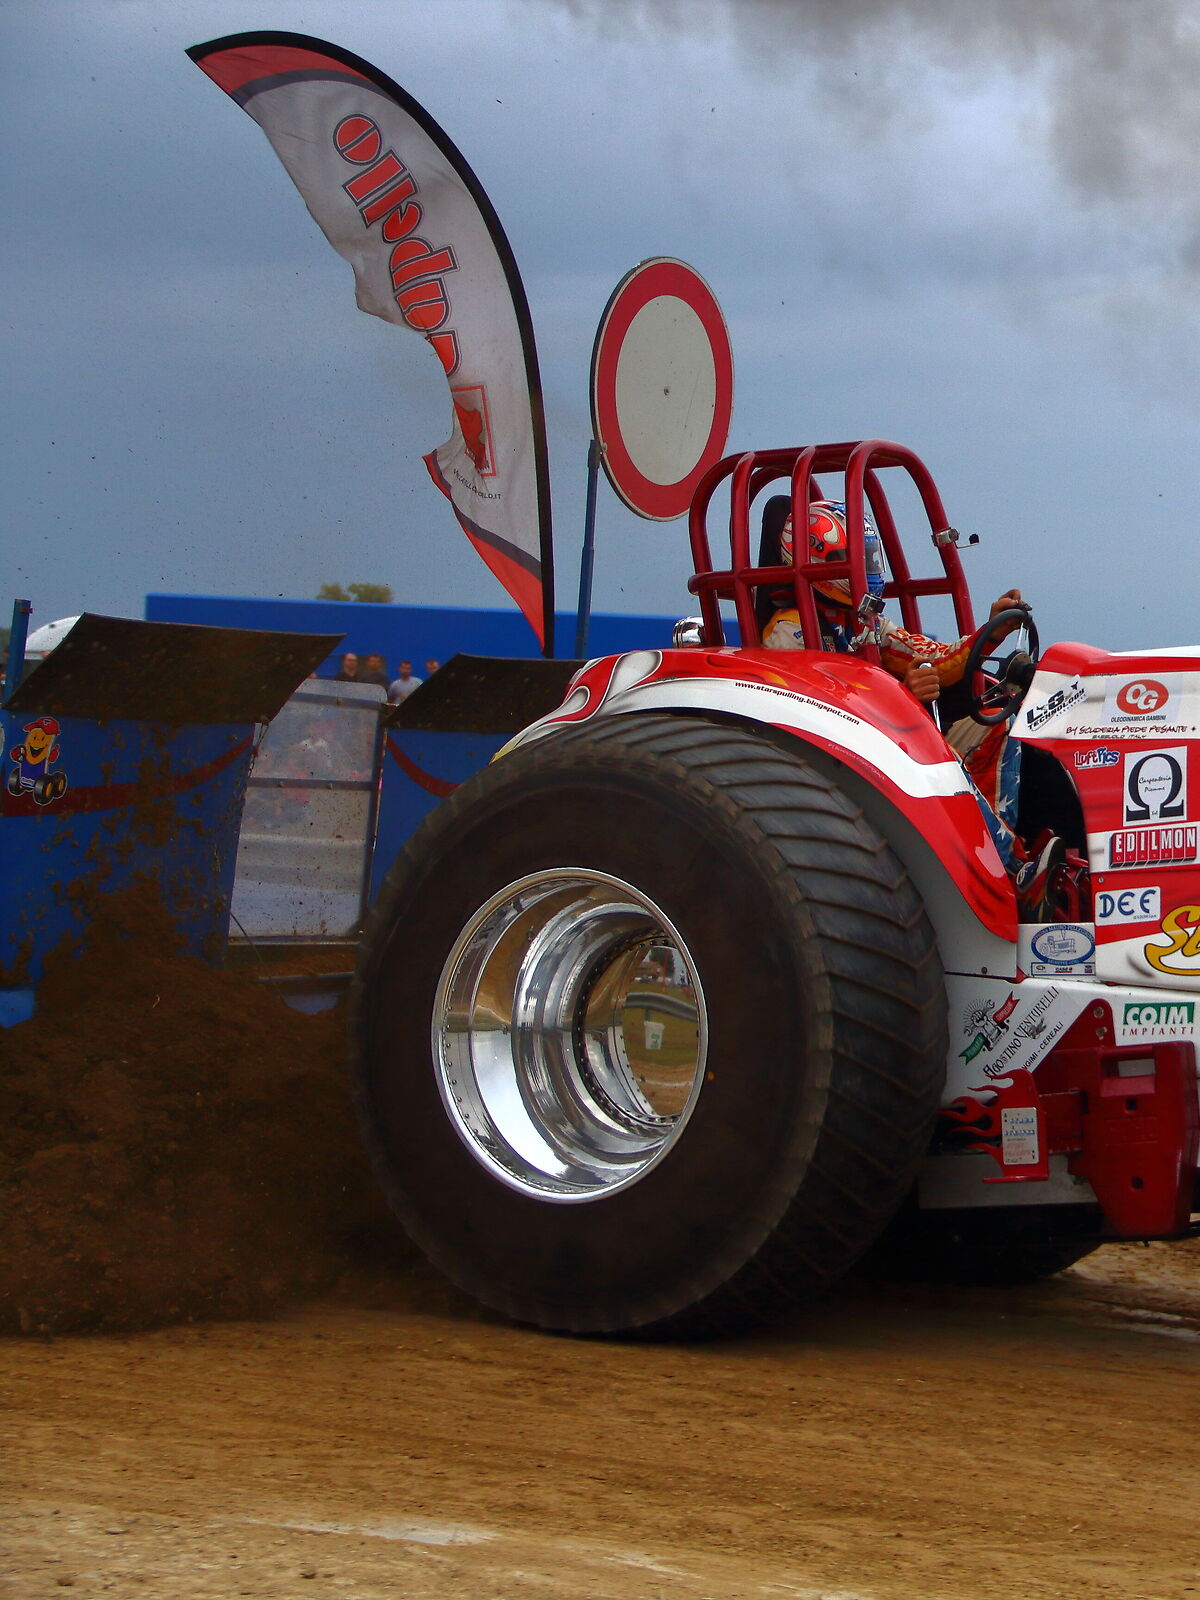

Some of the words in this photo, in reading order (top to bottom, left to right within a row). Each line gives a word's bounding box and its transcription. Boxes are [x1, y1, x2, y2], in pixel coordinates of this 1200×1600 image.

[735, 681, 860, 726] www.starspulling.blogspot.com
[1028, 688, 1086, 731] TECHNOLOGY
[1126, 683, 1159, 710] OG
[1138, 775, 1172, 785] Carpenteria
[1115, 828, 1197, 853] EDILMON
[1126, 1006, 1188, 1025] COIM
[983, 1038, 1022, 1076] AGOSTINO
[1013, 985, 1060, 1039] VENTURELLI
[1039, 1021, 1064, 1050] CEREALI
[1122, 1027, 1194, 1036] IMPIANTI
